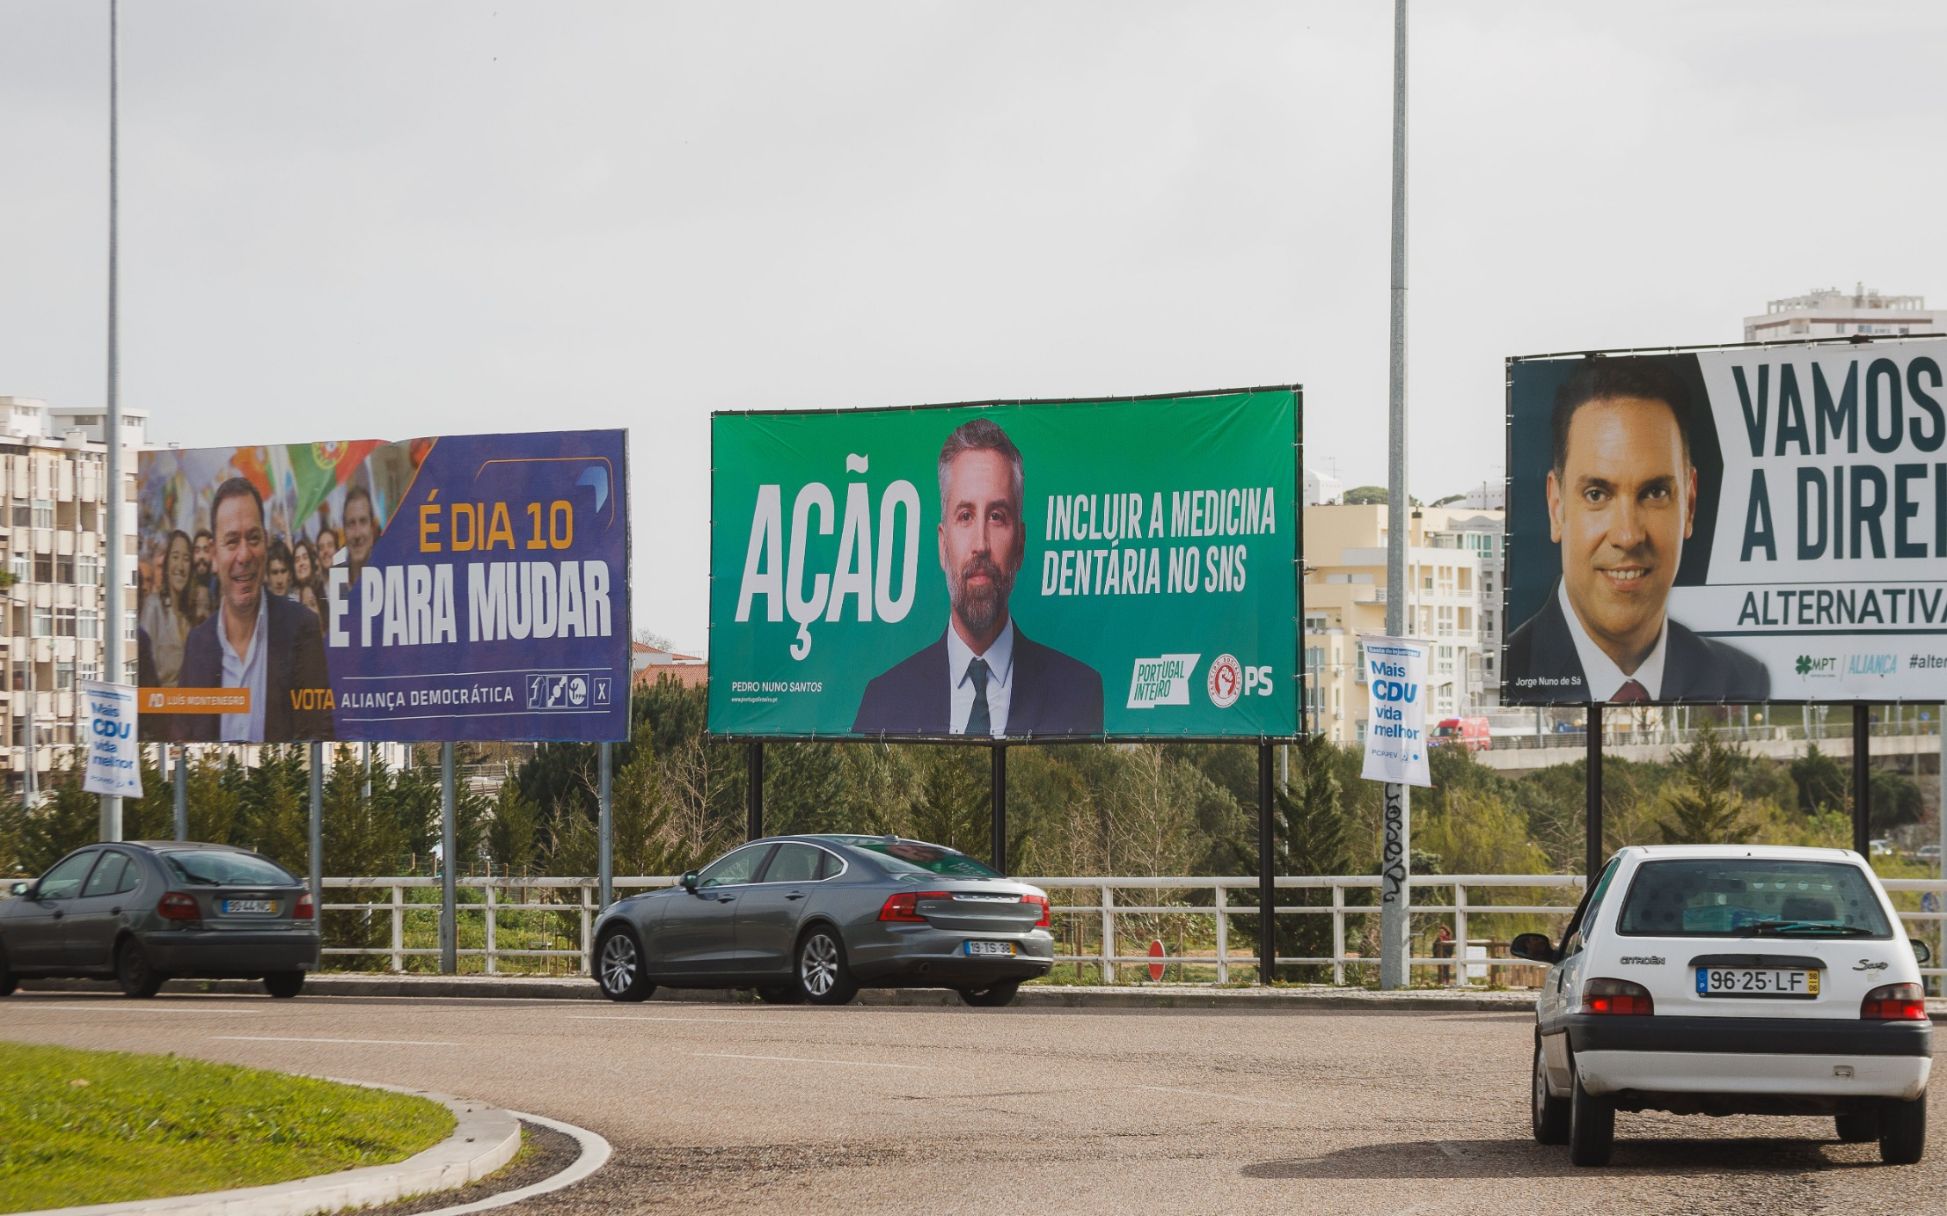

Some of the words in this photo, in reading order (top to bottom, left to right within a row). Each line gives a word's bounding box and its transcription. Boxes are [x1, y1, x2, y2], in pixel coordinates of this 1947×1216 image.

[1731, 356, 1946, 457] VAMOS
[420, 489, 442, 553] É
[451, 502, 515, 551] DIA
[527, 500, 573, 550] 10
[1046, 493, 1143, 541] INCLUIR
[1148, 492, 1164, 538] A
[1170, 487, 1275, 538] MEDICINA
[1740, 468, 1777, 562] A
[735, 453, 921, 660] AÇÃO
[1041, 539, 1160, 596] DENTÁRIA
[1167, 546, 1200, 594] NO
[1205, 544, 1247, 593] SNS
[329, 547, 350, 647] É
[361, 564, 457, 647] PARA
[468, 561, 612, 642] MUDAR
[1737, 588, 1947, 626] ALTERNATIV
[1137, 660, 1185, 682] PORTUGAL
[1371, 660, 1406, 678] Mais
[1812, 657, 1837, 671] MPT
[732, 681, 760, 692] PEDRO
[762, 681, 788, 692] NUNO
[789, 681, 823, 693] SANTOS
[1133, 680, 1171, 701] INTEIRO
[1244, 665, 1274, 697] PS
[1372, 679, 1418, 704] CDU
[1516, 676, 1537, 688] Jorge
[1539, 676, 1559, 686] Nuno
[1560, 676, 1570, 686] de
[290, 688, 336, 711] VOTA
[341, 691, 406, 712] ALIANÇA
[410, 684, 514, 707] DEMOCRÁTICA
[1375, 704, 1403, 721] vida
[93, 718, 131, 740] CDU
[1374, 724, 1420, 740] melhor
